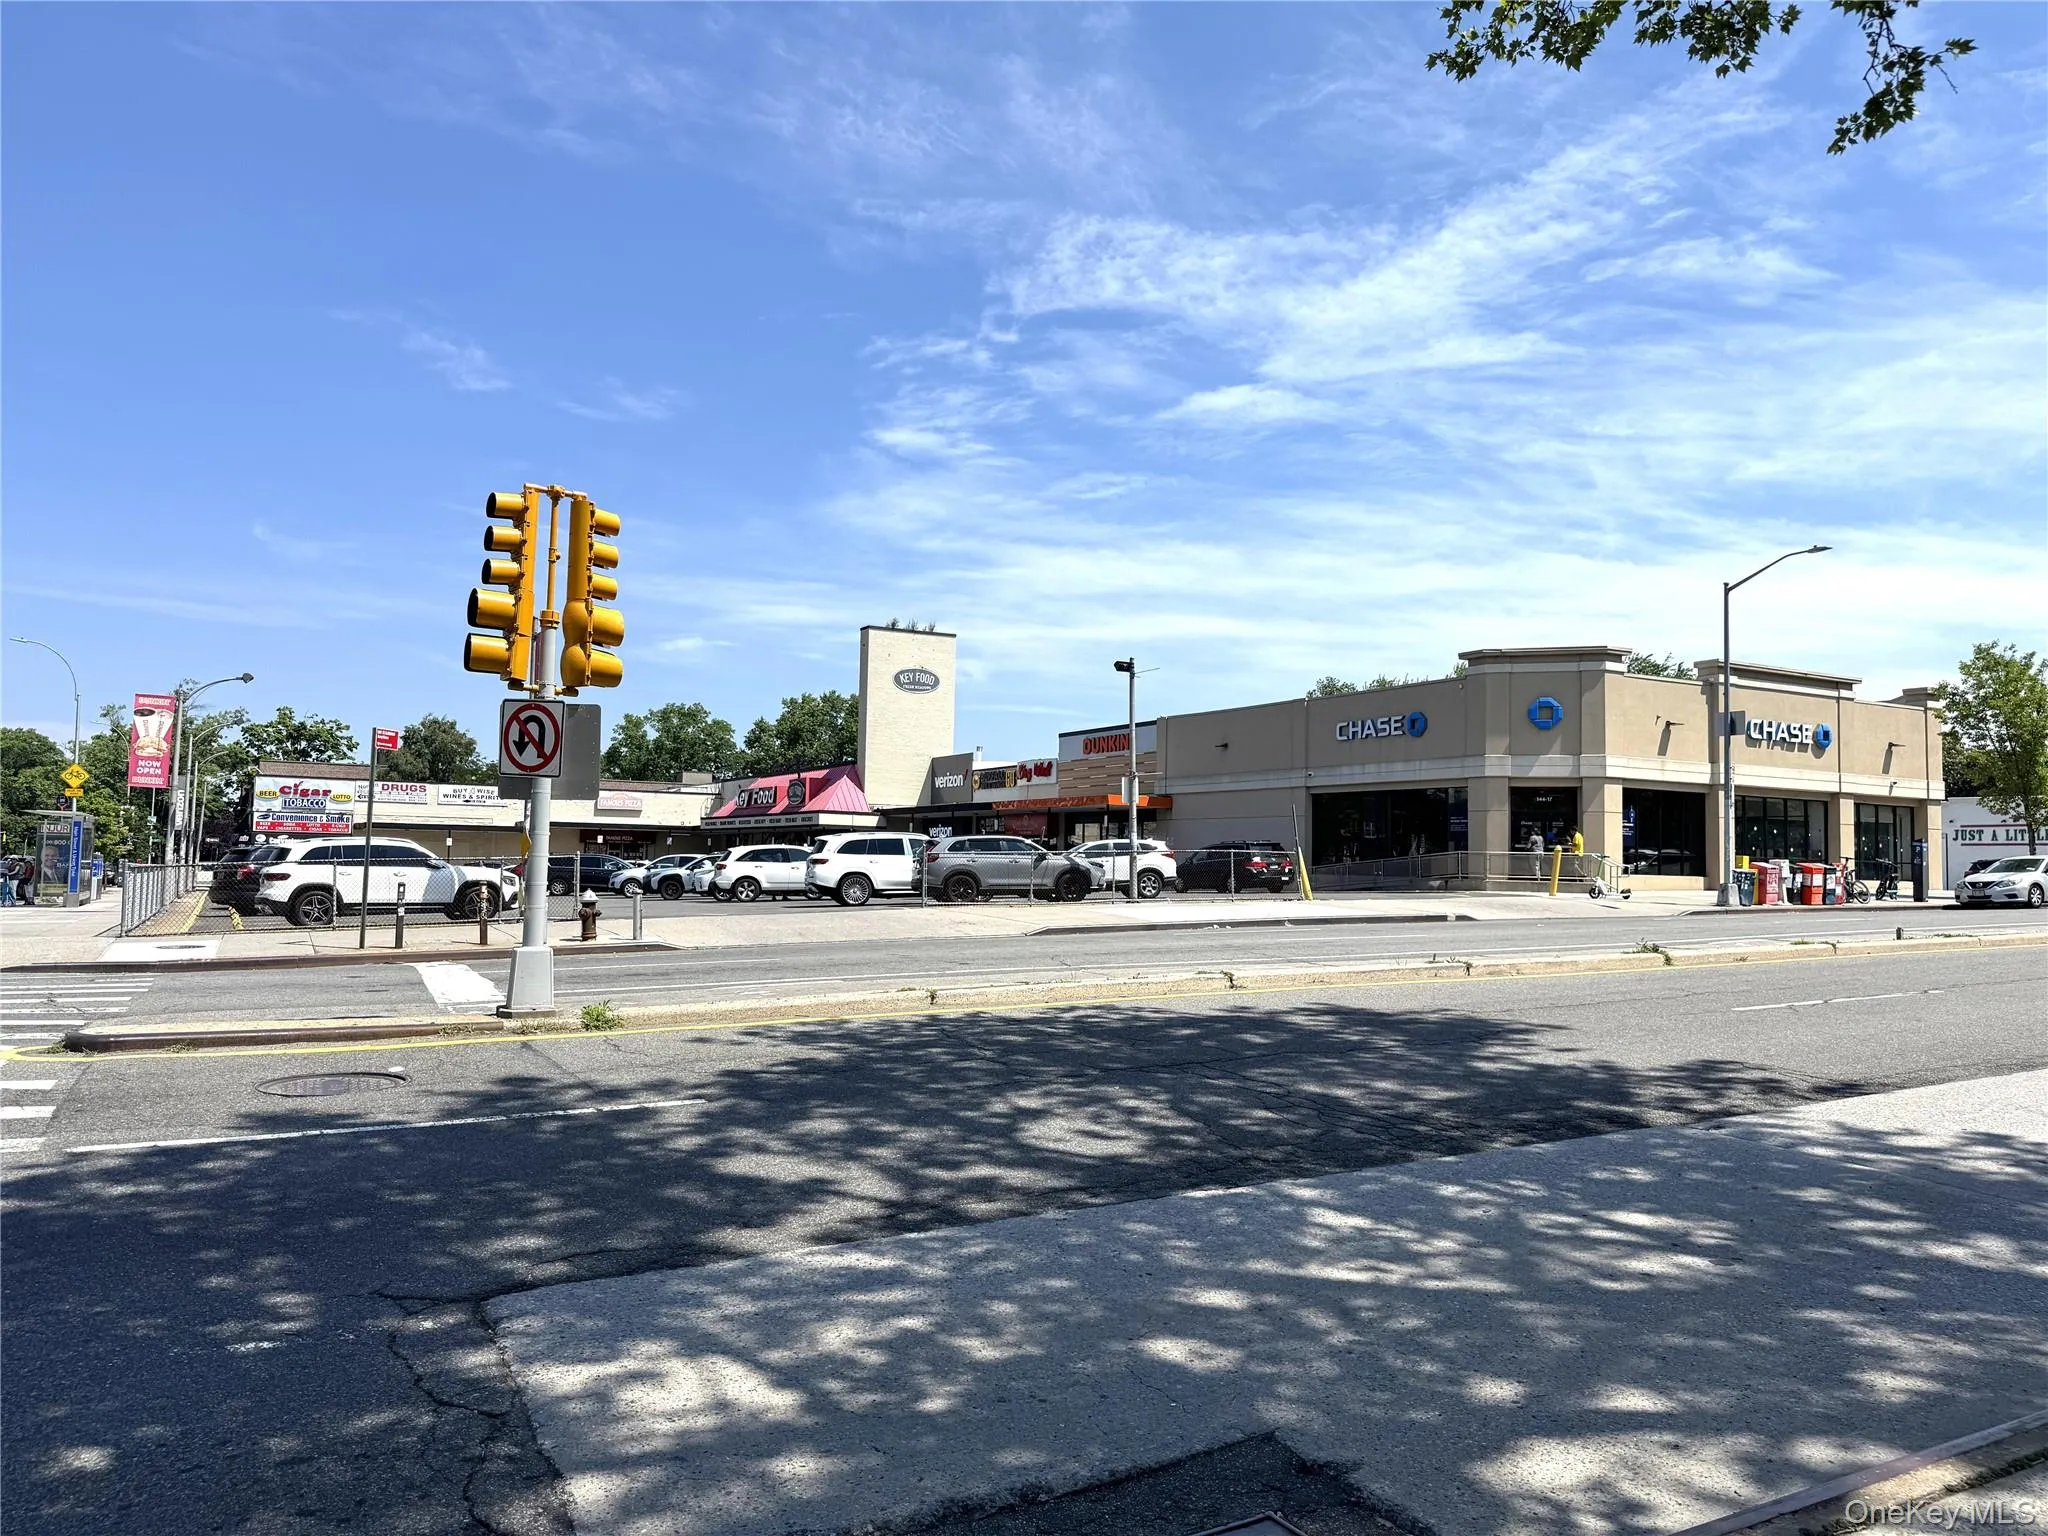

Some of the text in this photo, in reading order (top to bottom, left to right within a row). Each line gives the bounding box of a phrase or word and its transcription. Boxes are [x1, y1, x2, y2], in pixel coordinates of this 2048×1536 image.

[899, 672, 935, 685] KEY FOOD
[1336, 715, 1405, 742] CHASE
[1749, 719, 1813, 744] CHASE
[136, 767, 161, 775] OPEN
[934, 772, 964, 789] verizon
[279, 782, 332, 798] Cigar
[381, 783, 427, 793] DRUGS
[751, 786, 775, 805] Food
[175, 789, 185, 826] verizon
[284, 799, 326, 807] TOBACCO
[271, 813, 318, 822] Convenience
[325, 814, 350, 823] Smoke
[928, 824, 953, 838] verizon
[1952, 829, 2048, 841] JUST A LITL
